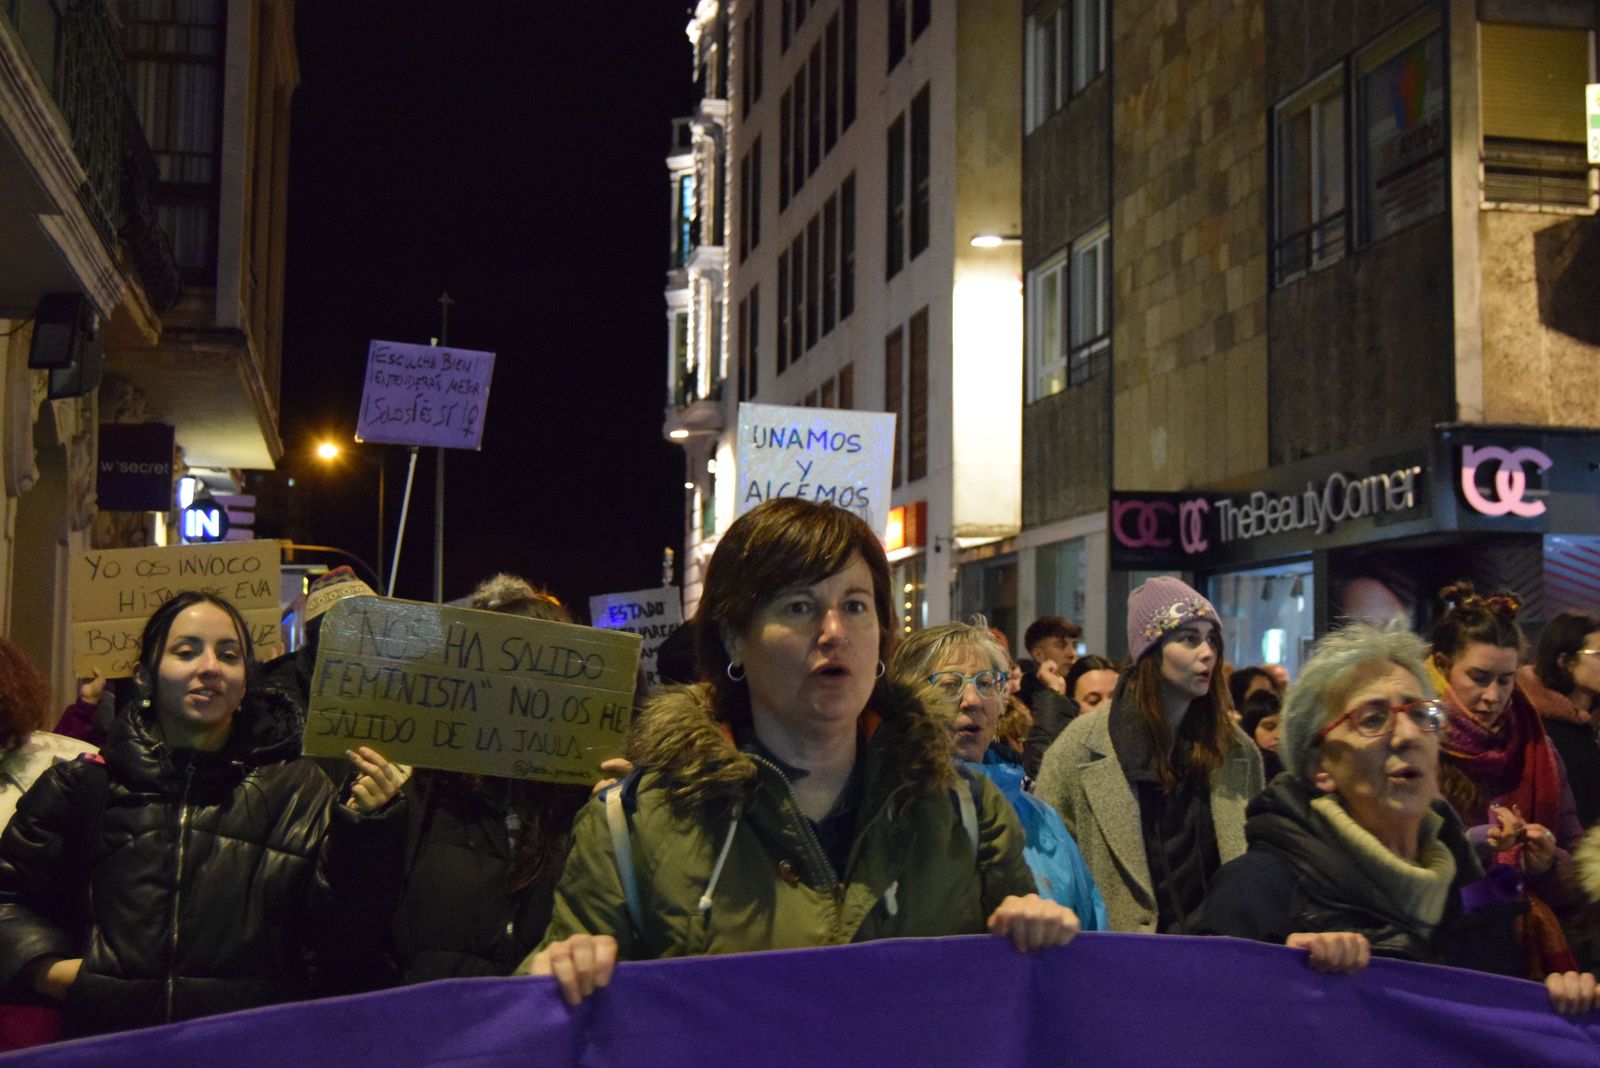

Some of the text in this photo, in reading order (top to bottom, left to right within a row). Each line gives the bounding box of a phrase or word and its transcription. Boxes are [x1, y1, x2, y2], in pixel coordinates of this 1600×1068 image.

[753, 425, 862, 453] UNAMOS
[796, 460, 813, 482] Y
[185, 509, 220, 538] IN
[85, 553, 261, 581] YO OS INVOCO
[235, 579, 272, 600] EVA
[607, 601, 665, 623] ESTADO
[445, 625, 483, 672] HA
[501, 636, 605, 681] SALIDO
[562, 695, 591, 725] OS
[599, 704, 629, 734] HE
[317, 706, 584, 761] SALIDO DE LA JAULA
